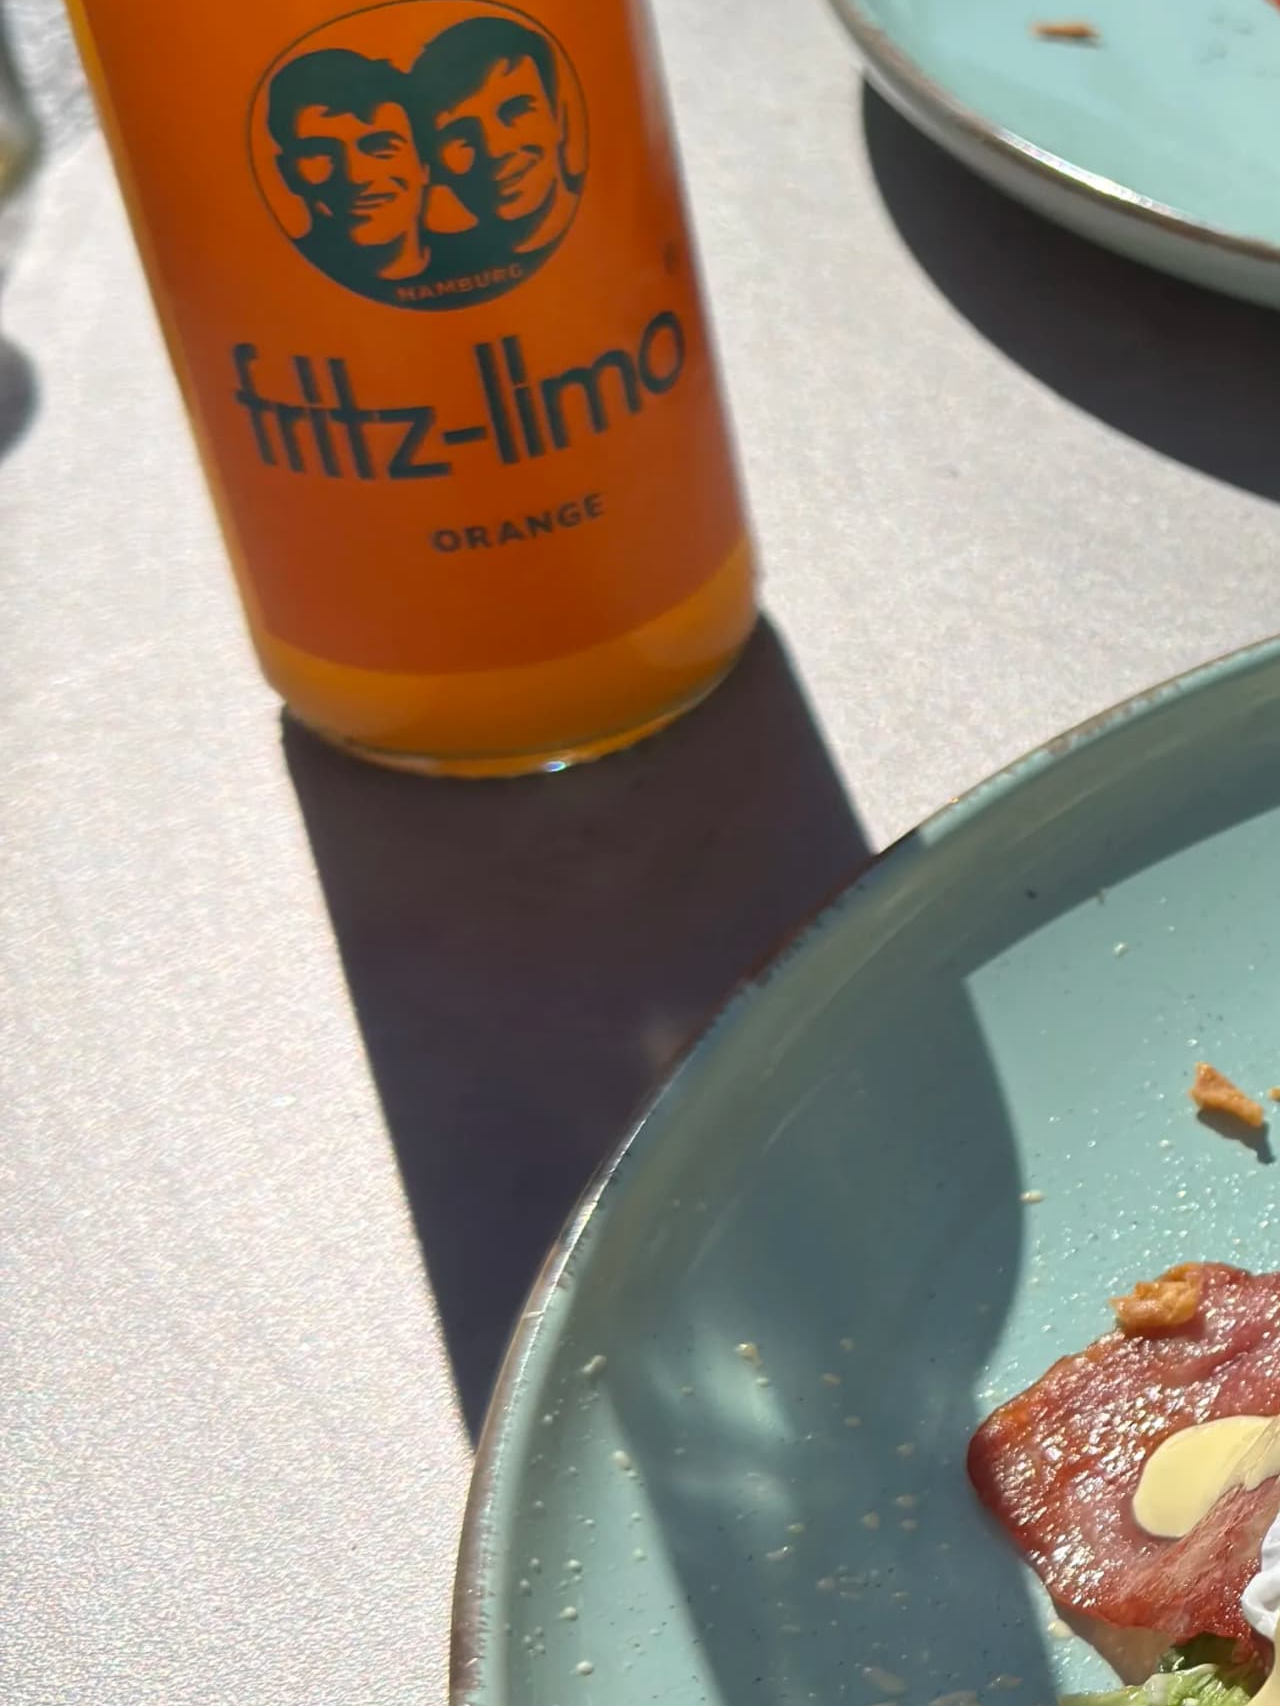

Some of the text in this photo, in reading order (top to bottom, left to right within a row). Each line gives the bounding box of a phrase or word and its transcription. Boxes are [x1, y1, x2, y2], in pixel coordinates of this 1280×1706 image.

[395, 262, 522, 302] HAMBURG
[231, 309, 686, 481] fritz-limo
[431, 491, 606, 554] ORANGE
